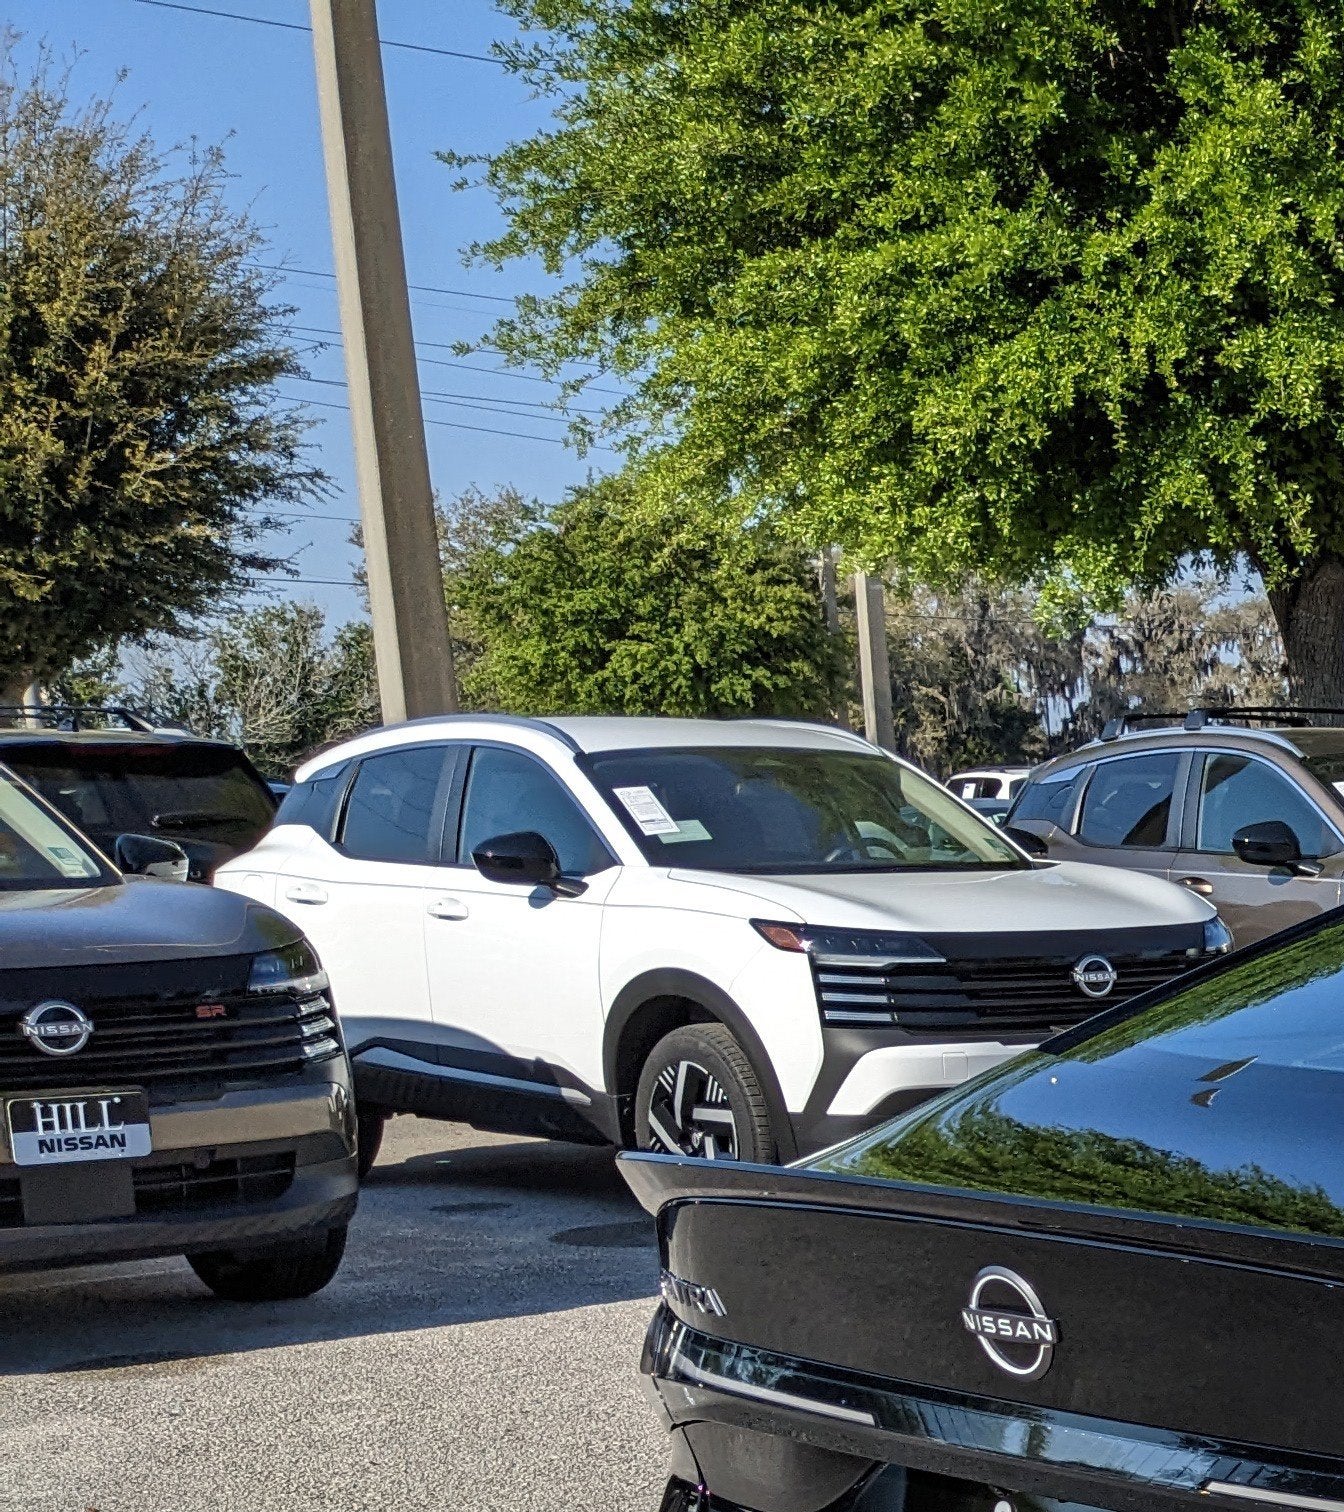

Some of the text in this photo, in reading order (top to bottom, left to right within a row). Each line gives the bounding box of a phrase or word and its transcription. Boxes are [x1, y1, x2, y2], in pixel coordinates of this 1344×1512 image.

[1075, 971, 1117, 982] NISSAN
[195, 1004, 227, 1018] SR
[25, 1020, 94, 1036] NISSAN
[33, 1099, 125, 1136] HILL
[38, 1133, 127, 1154] NISSAN
[962, 1310, 1053, 1341] NISSAN
